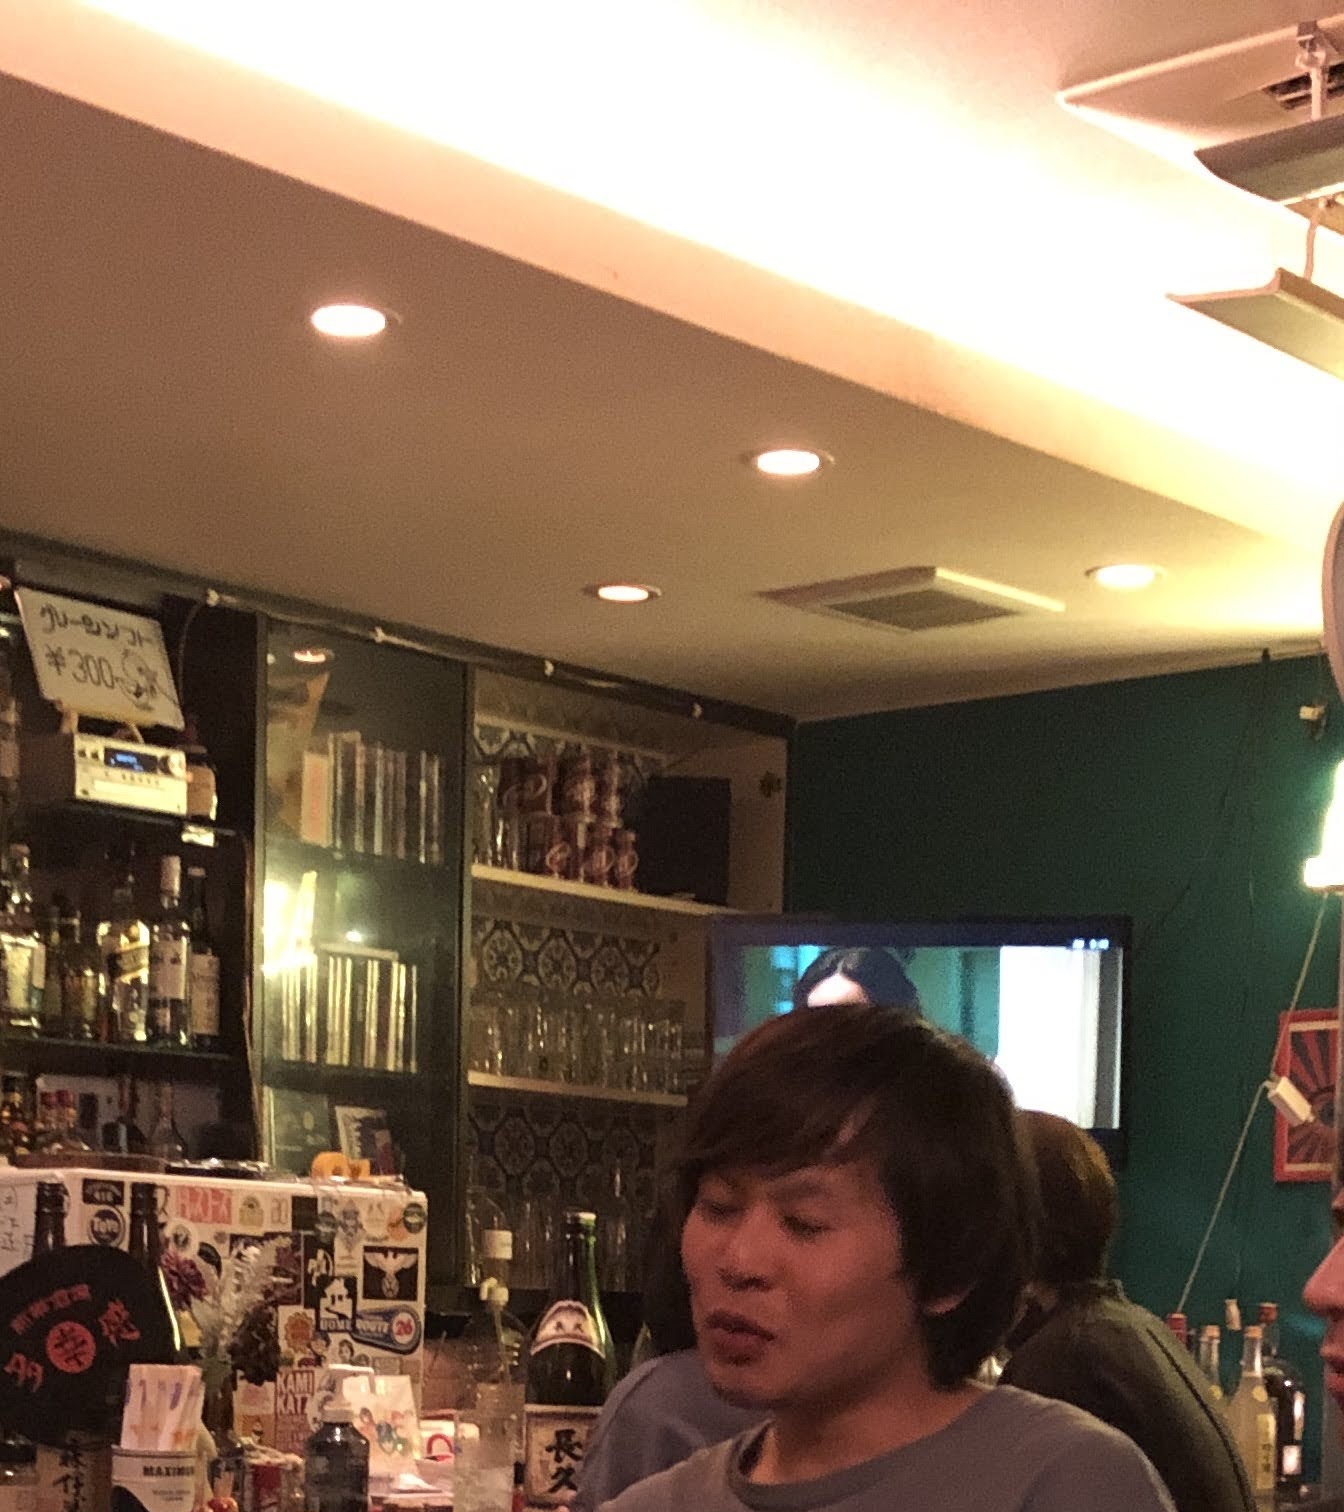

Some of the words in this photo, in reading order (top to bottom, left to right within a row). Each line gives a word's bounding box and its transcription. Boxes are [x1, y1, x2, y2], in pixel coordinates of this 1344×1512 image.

[395, 1318, 413, 1335] 26
[276, 1372, 313, 1394] KAMI
[545, 1428, 584, 1493] 長久
